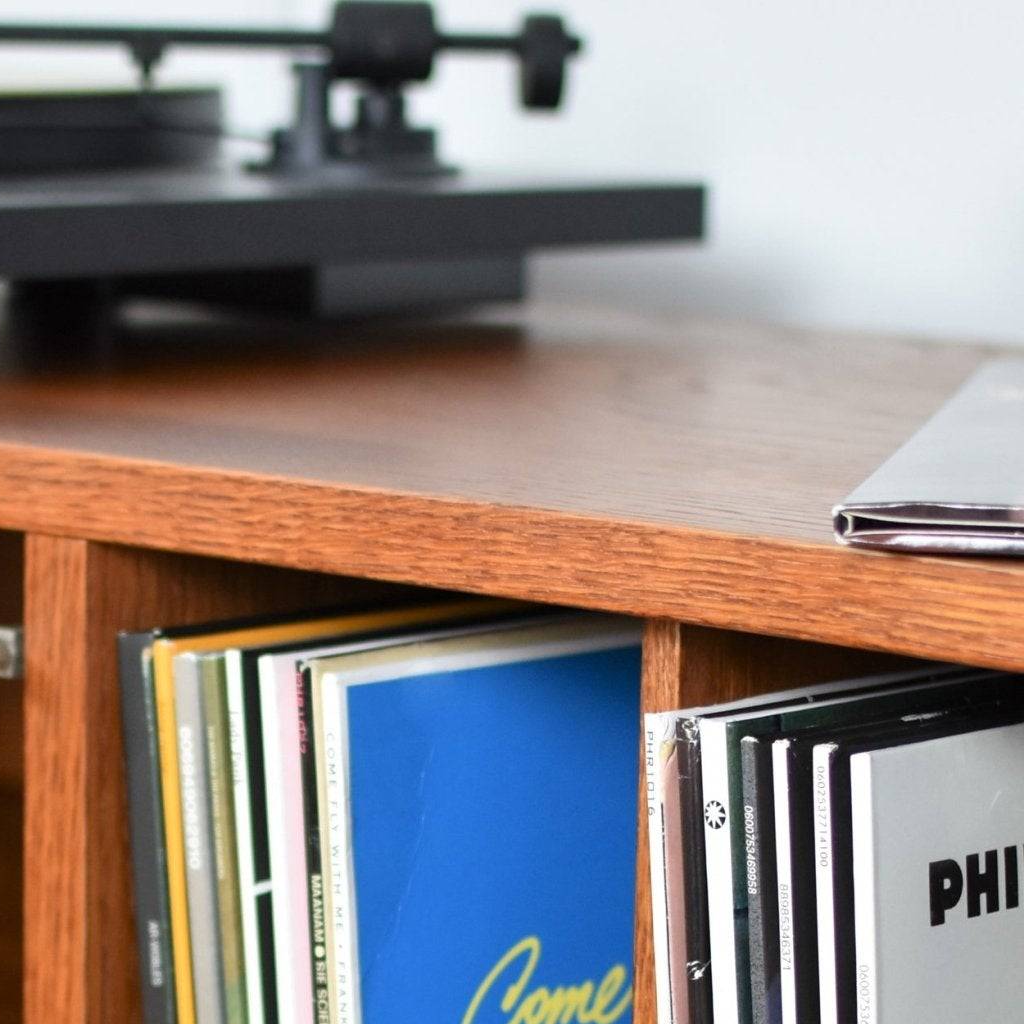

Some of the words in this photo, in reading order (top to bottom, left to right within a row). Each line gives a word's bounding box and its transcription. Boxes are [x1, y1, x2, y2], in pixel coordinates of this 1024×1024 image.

[326, 732, 337, 786] COME
[330, 801, 339, 833] FLY
[816, 765, 829, 867] 0602537714100
[332, 845, 342, 895] WITH
[743, 805, 757, 895] 0600753469958
[311, 874, 325, 943] MAANAM
[928, 843, 1024, 927] PHI
[334, 906, 344, 931] ME
